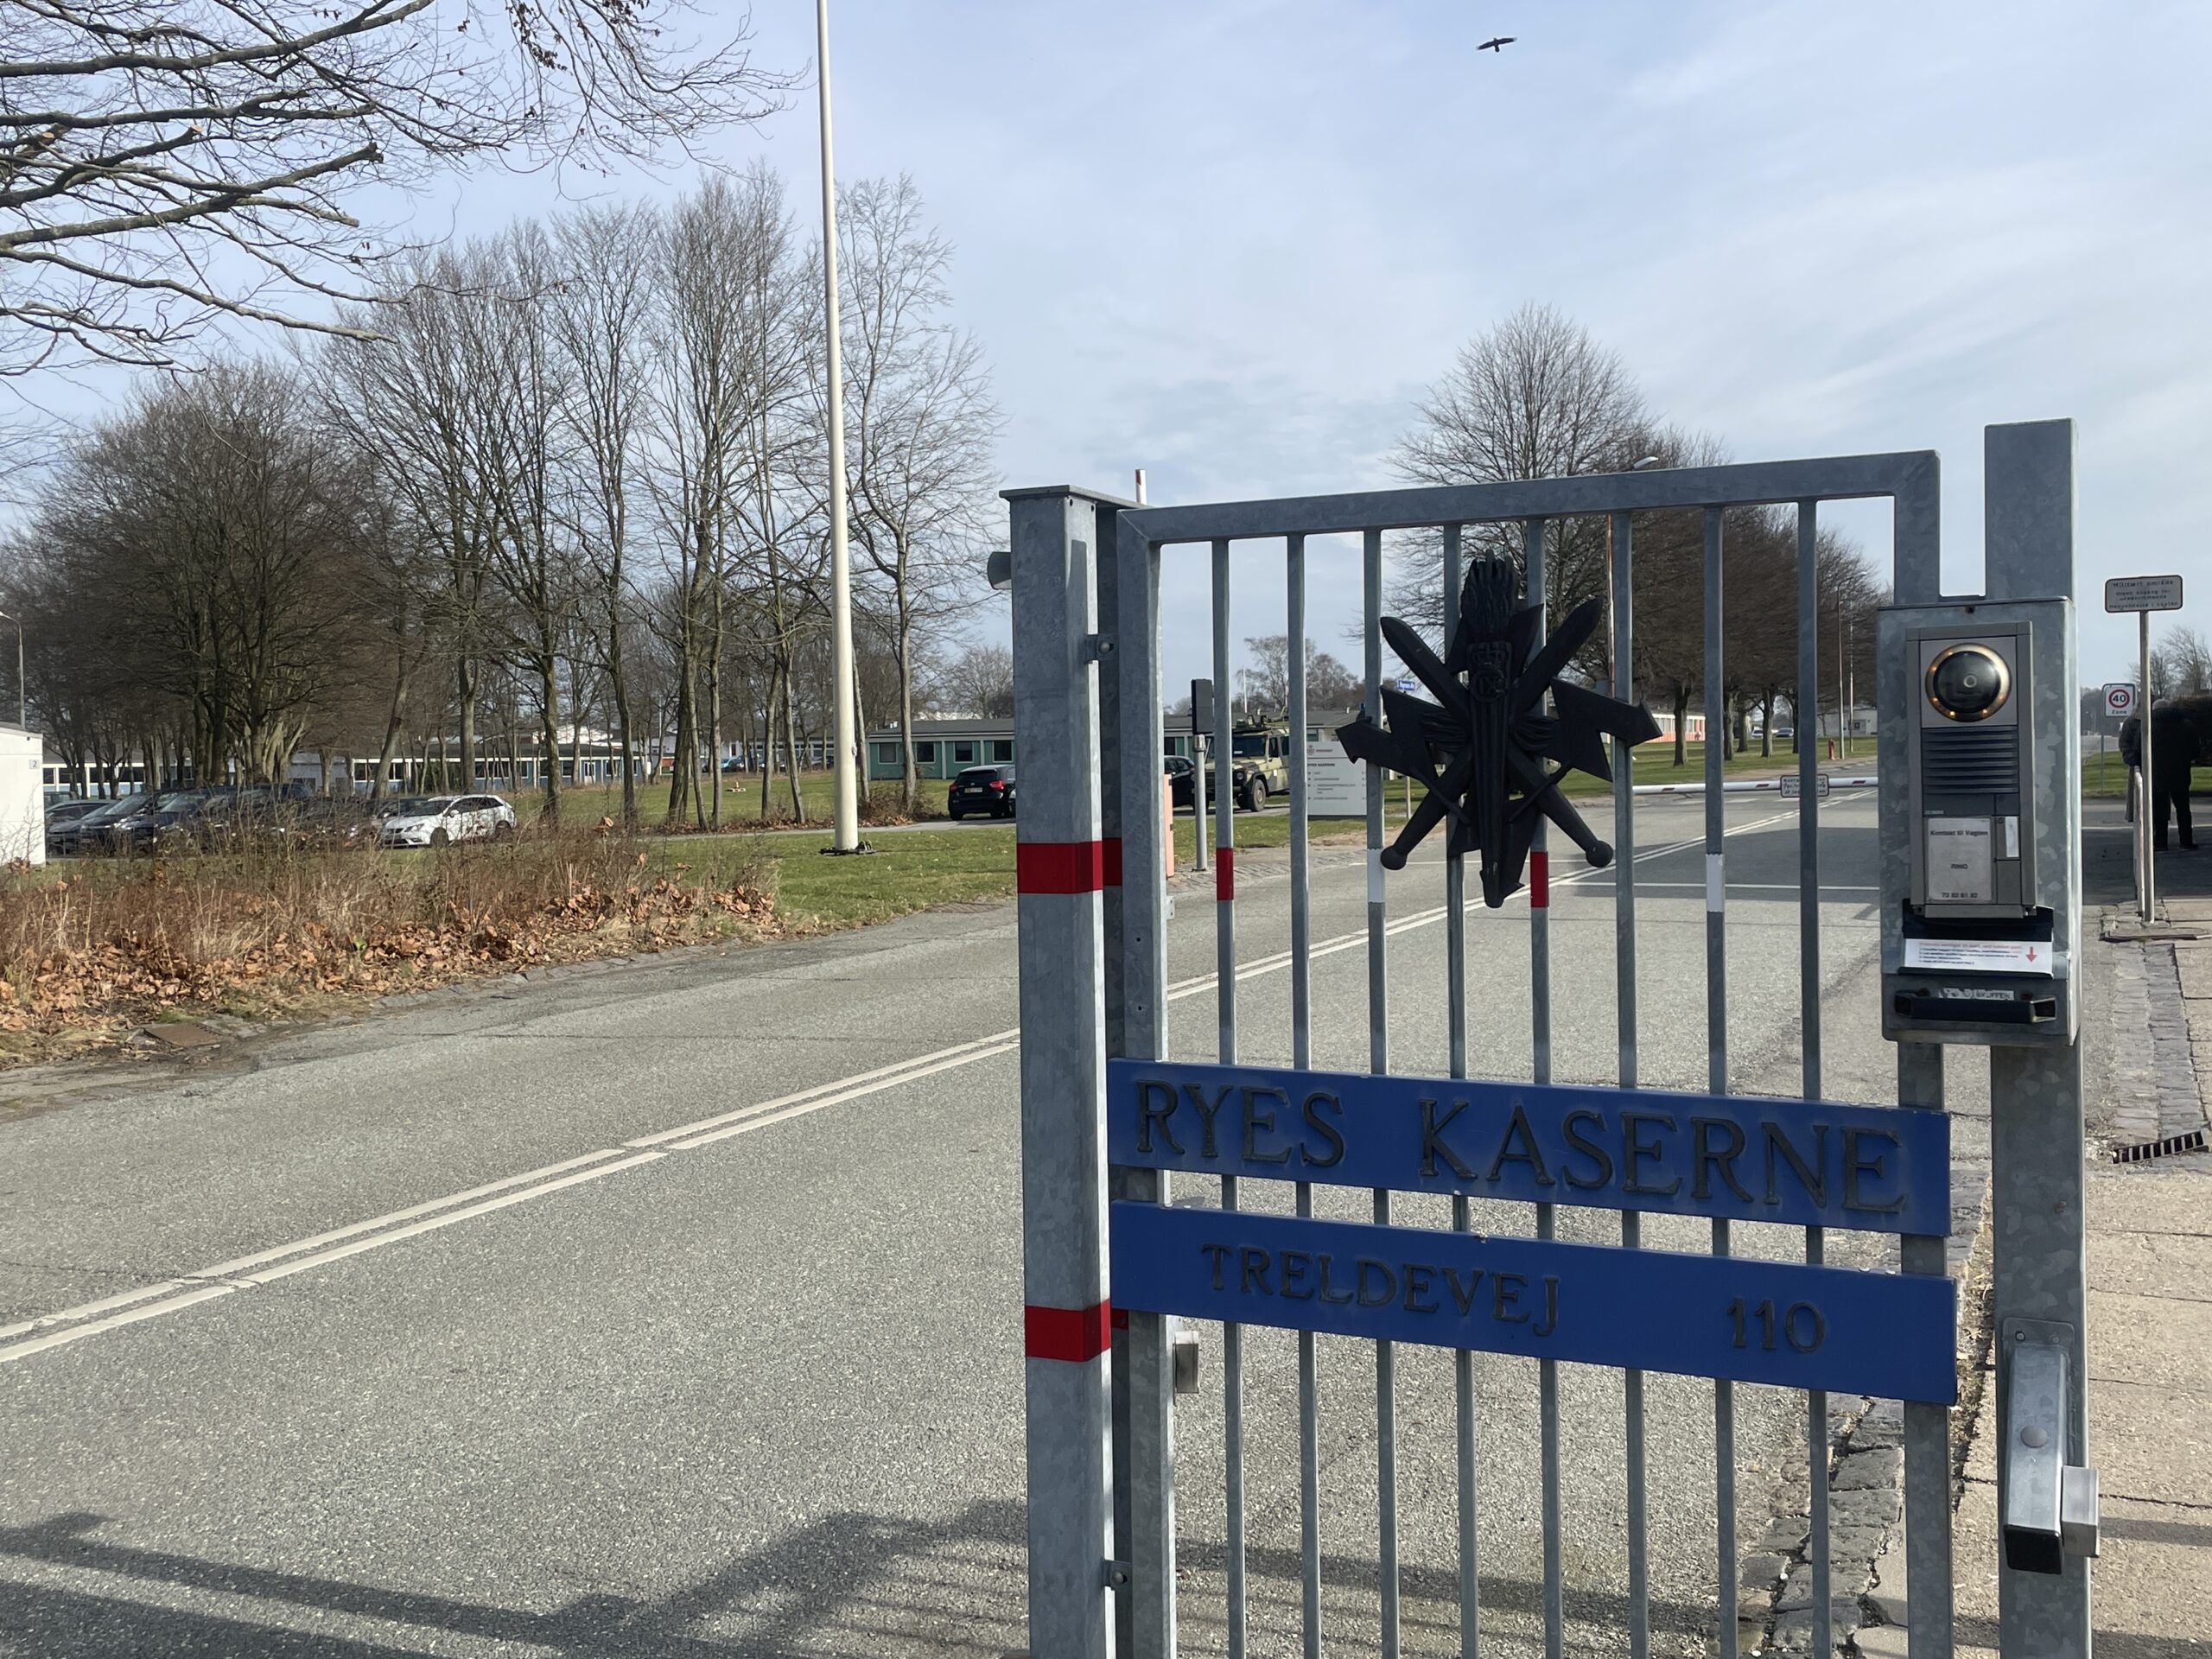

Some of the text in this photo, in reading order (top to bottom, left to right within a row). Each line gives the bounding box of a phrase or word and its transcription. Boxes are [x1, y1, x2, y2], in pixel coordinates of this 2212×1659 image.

[2113, 694, 2126, 702] 40
[1136, 1079, 1907, 1213] RYES KASERNE
[1201, 1243, 1826, 1354] TRELDEVEJ 110
